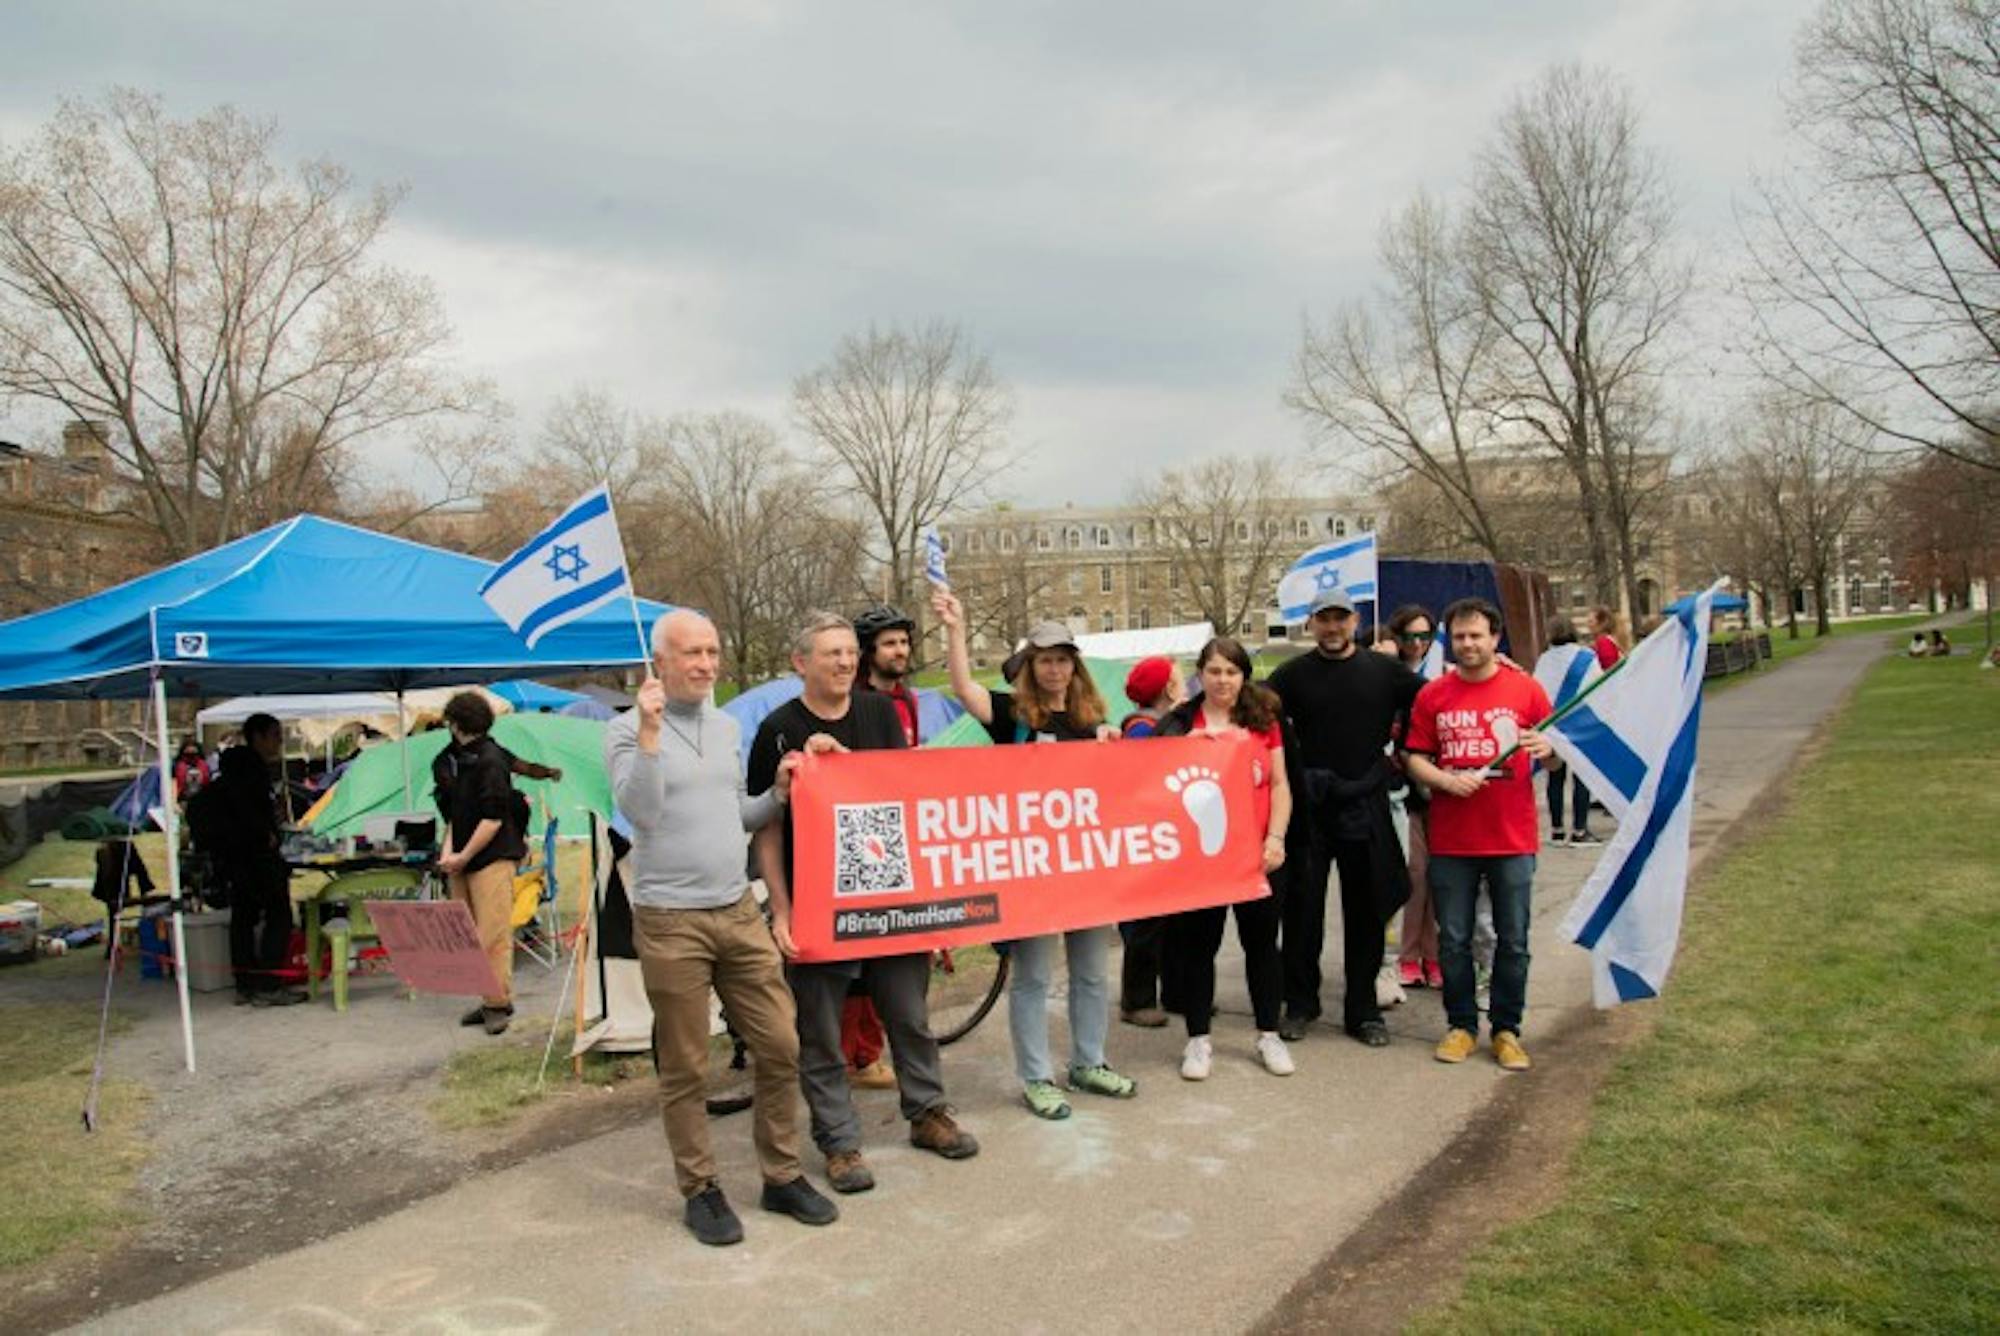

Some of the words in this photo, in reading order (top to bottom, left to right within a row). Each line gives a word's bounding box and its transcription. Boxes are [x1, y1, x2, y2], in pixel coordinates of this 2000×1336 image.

[1436, 710, 1477, 729] RUN
[918, 795, 1010, 841] RUN
[1017, 788, 1100, 831] FOR
[920, 838, 1051, 888] THEIR
[1059, 823, 1181, 874] LIVES
[837, 902, 994, 934] #BringThemHomeNow
